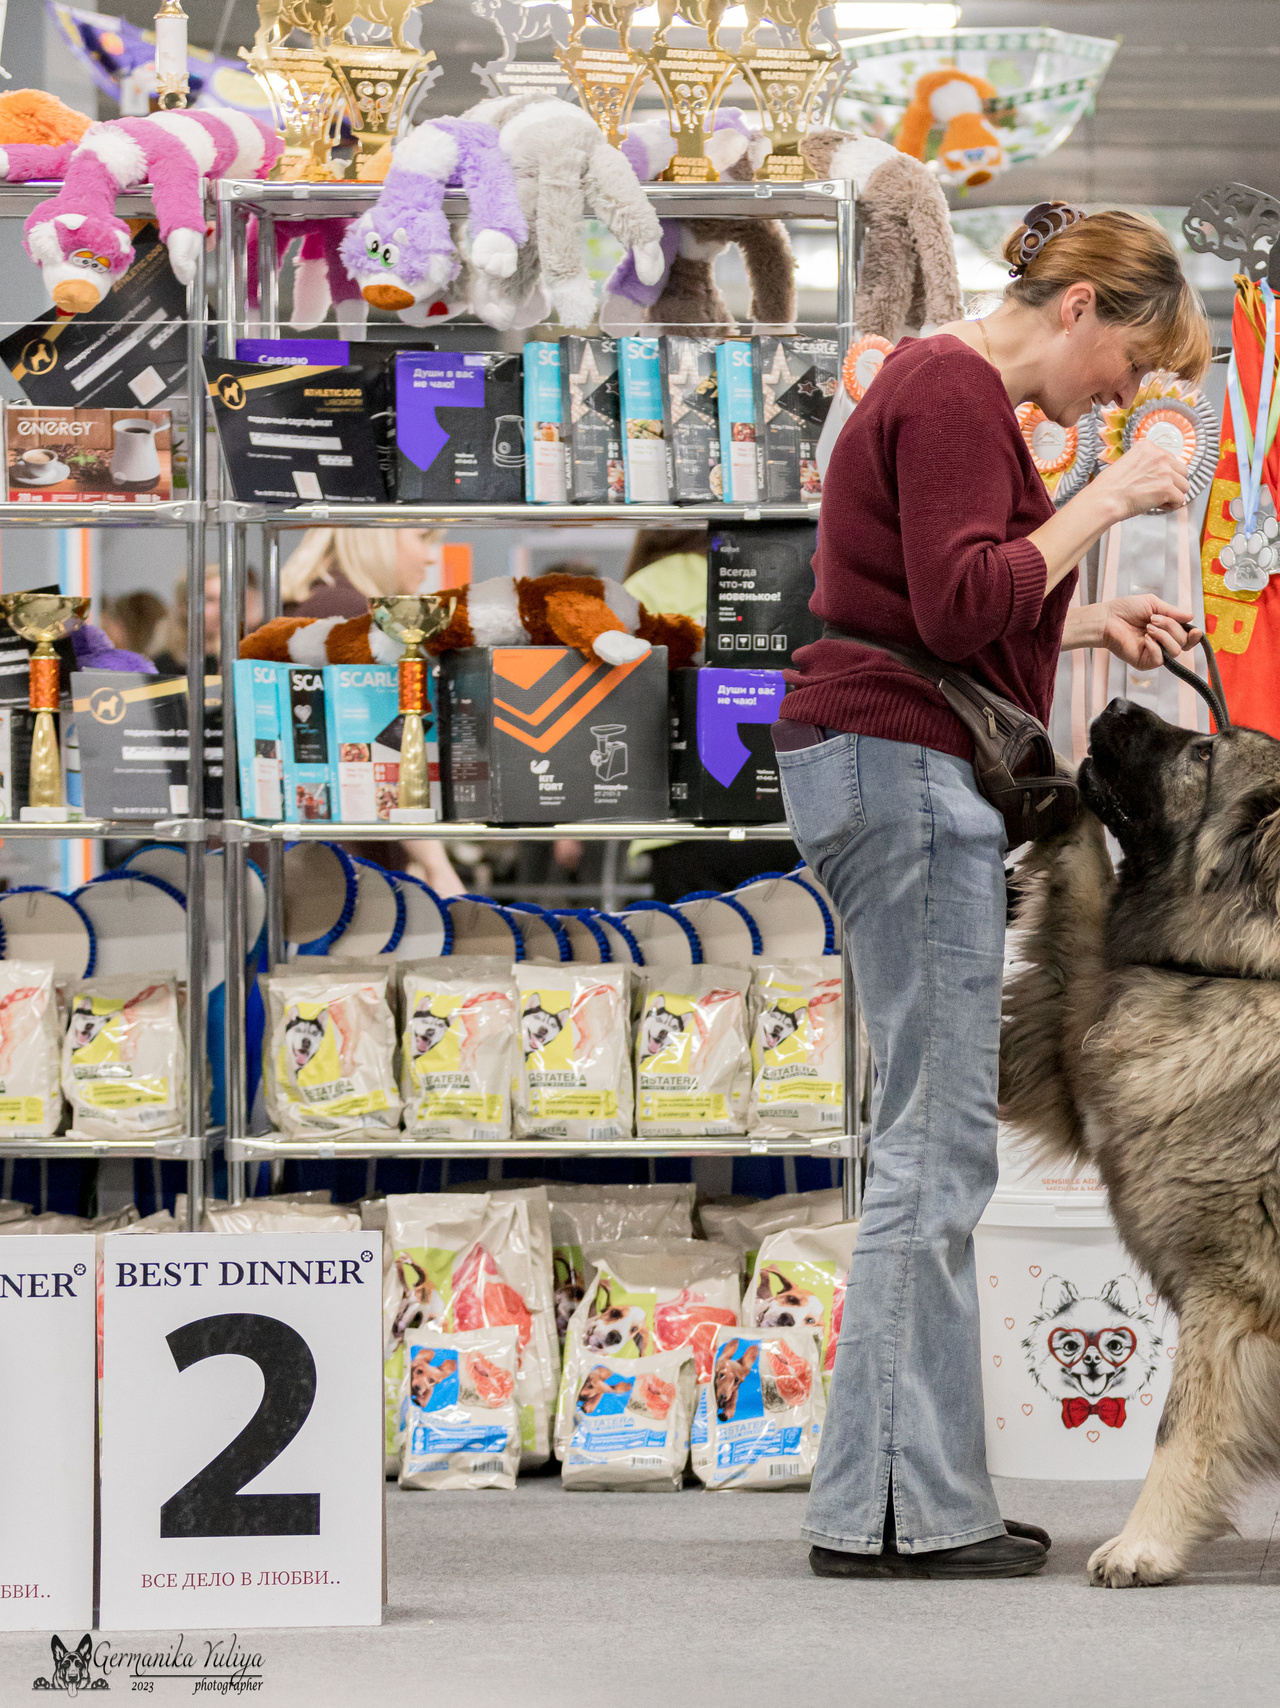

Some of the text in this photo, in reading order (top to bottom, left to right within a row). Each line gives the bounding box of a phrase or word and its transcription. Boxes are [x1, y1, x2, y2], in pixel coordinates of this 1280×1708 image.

[413, 368, 475, 379] Души в вас
[429, 380, 455, 389] чаю!
[304, 389, 362, 397] ATHLETIC DOG
[757, 447, 765, 490] SCARLETT
[719, 567, 756, 578] Всегда
[719, 581, 755, 589] что-то
[719, 592, 781, 601] новенькое!
[717, 684, 776, 695] Души в вас
[717, 696, 757, 706] не чаю!
[539, 774, 555, 783] KIT
[539, 783, 564, 791] FORT
[536, 1073, 587, 1082] STATERA
[115, 1259, 365, 1288] BEST DINNER
[160, 1312, 321, 1539] 2
[141, 1570, 342, 1590] ВСЕ ДЕЛО В ЛЮБВИ..
